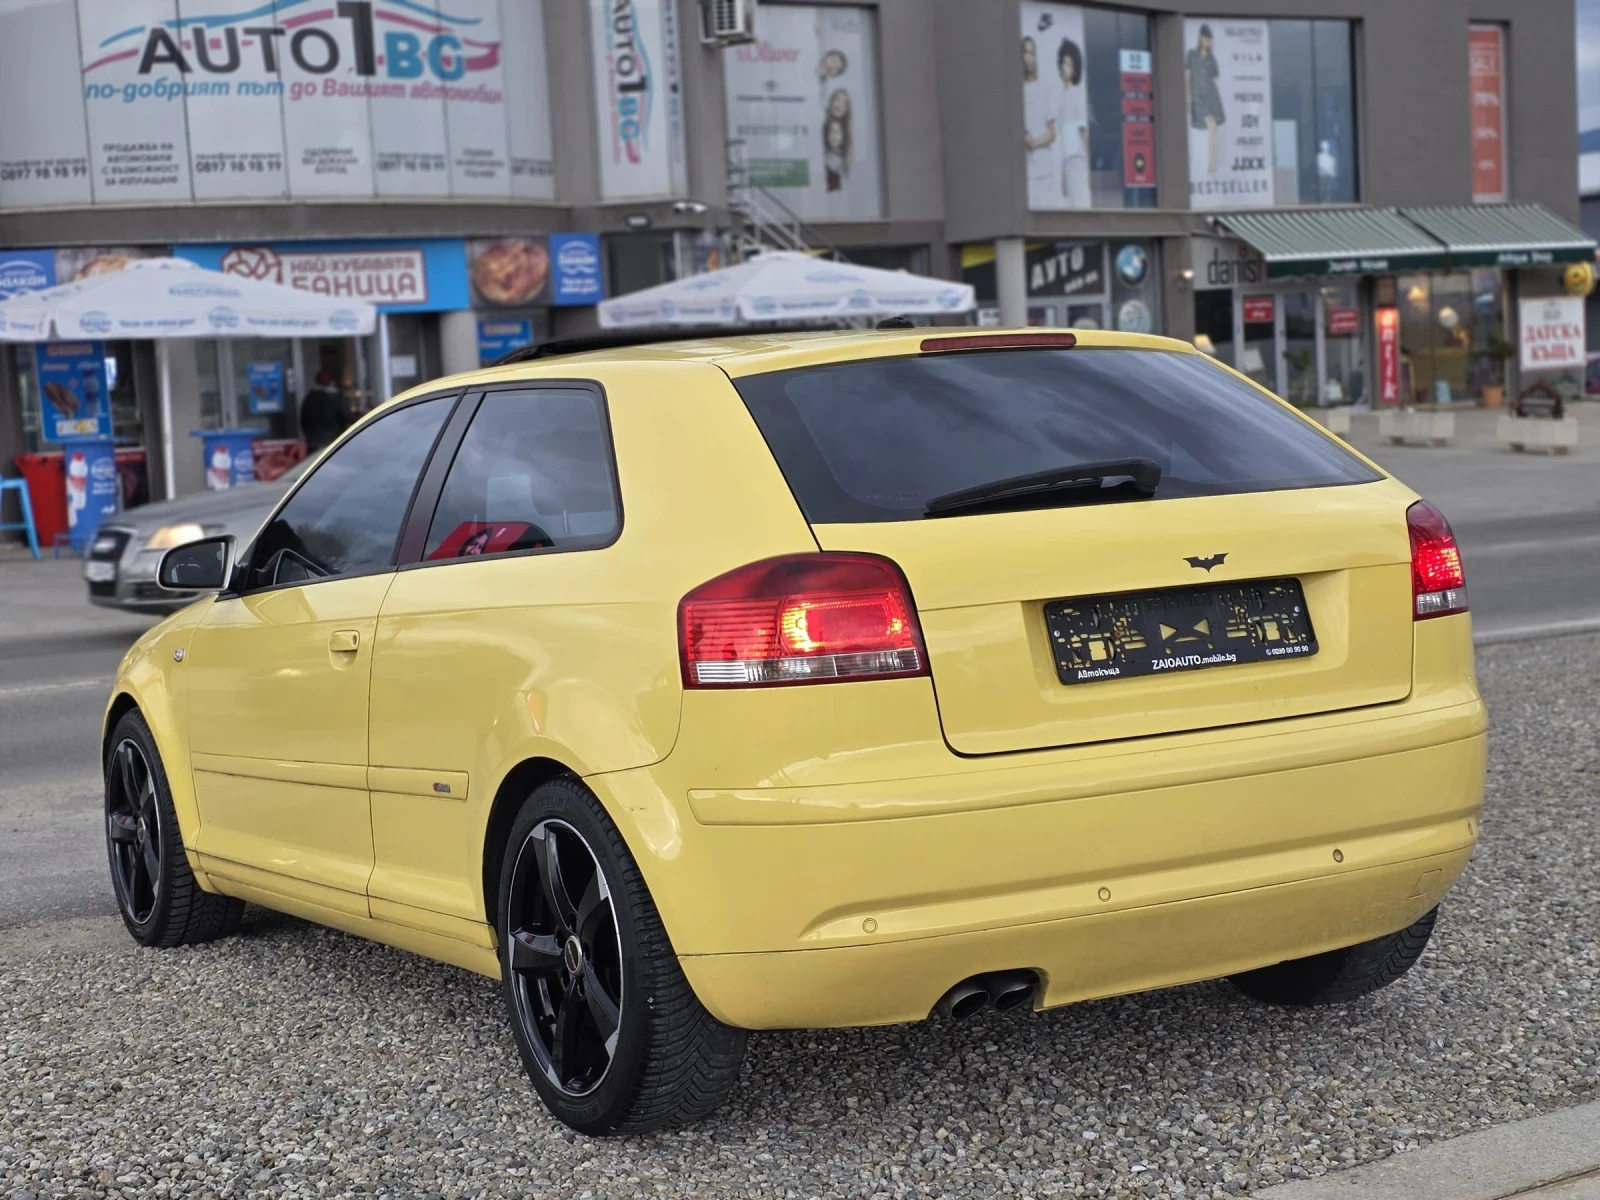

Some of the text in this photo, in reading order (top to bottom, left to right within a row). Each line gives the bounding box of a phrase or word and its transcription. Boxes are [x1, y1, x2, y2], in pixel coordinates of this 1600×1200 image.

[290, 80, 317, 101] до
[1525, 324, 1580, 342] ДАТСКА
[1531, 343, 1576, 361] КЪЩА
[1077, 667, 1121, 680] Автокъща
